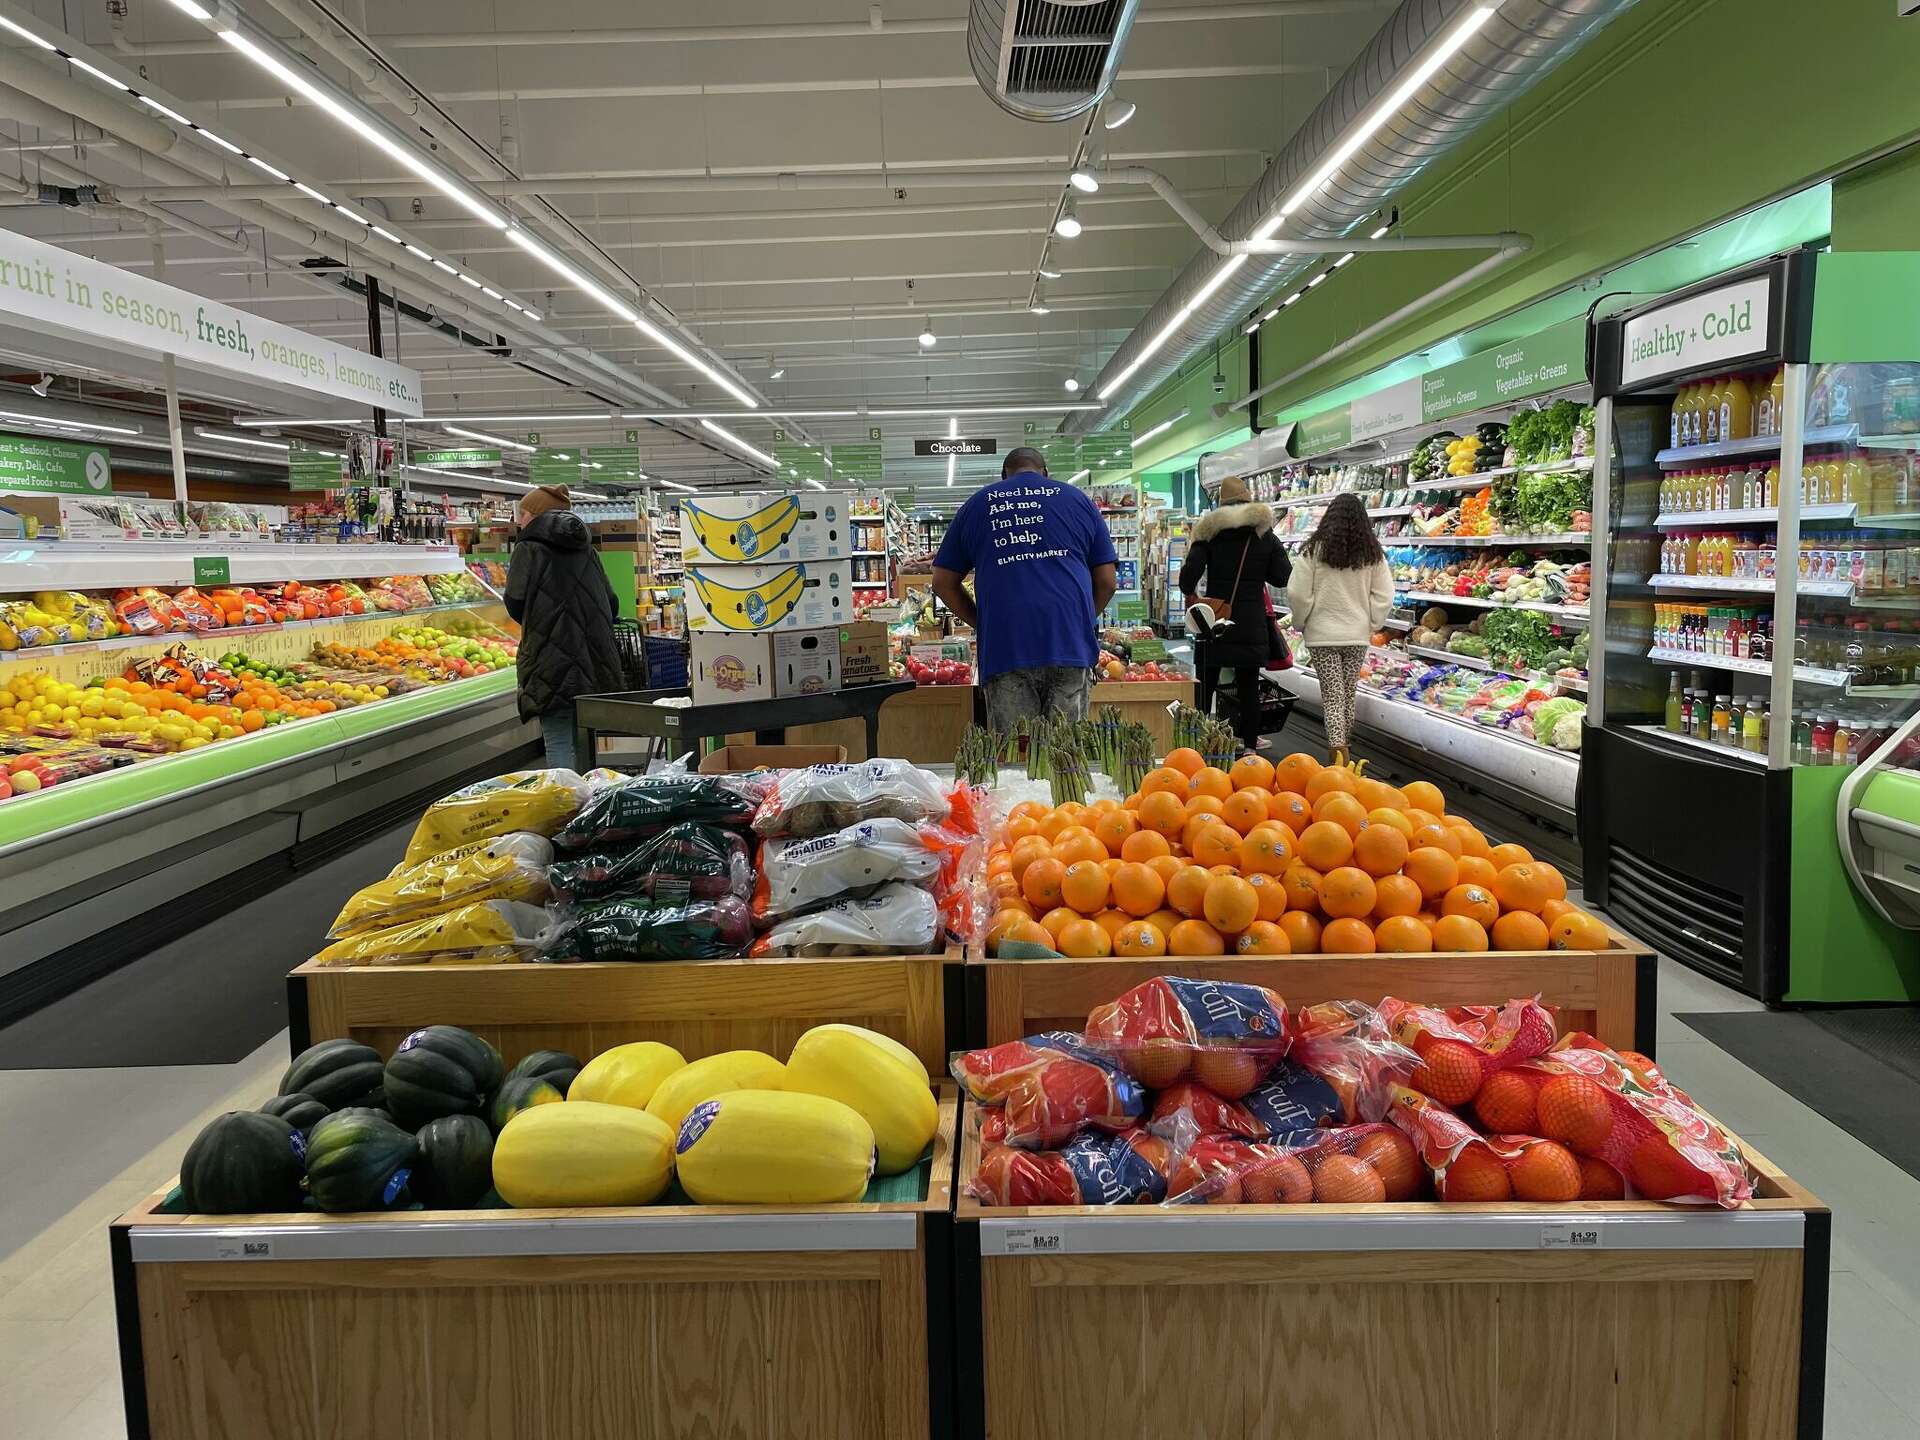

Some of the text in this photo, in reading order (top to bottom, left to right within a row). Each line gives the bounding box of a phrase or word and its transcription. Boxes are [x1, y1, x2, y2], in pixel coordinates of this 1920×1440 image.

[0, 258, 419, 403] ruit in season, fresh, oranges, lemons, etc...
[1631, 324, 1686, 363] Healthy
[1702, 300, 1752, 341] Cold
[1496, 348, 1524, 370] Organic
[1423, 375, 1446, 393] Organic
[1496, 370, 1533, 395] Vegetables
[1540, 362, 1568, 381] Greens
[1423, 393, 1452, 415] Vegetables
[1456, 389, 1478, 404] Greens
[530, 434, 537, 443] 3
[629, 431, 636, 441] 4
[775, 431, 782, 440] 5
[872, 429, 879, 438] 6
[0, 444, 13, 453] eat
[20, 444, 51, 457] Seafood,
[930, 443, 982, 453] Chocolate
[0, 457, 24, 471] akery,
[427, 453, 444, 461] Oils
[452, 453, 489, 462] Vinegars
[0, 474, 30, 487] repared
[31, 475, 53, 487] Foods
[988, 486, 1061, 502] Need help?
[989, 500, 1042, 515] Ask me,
[991, 513, 1044, 531] I'm here
[994, 530, 1042, 548] to help.
[997, 549, 1069, 566] ELM CITY MARKET
[846, 655, 871, 666] Fresh
[842, 664, 881, 676] omatoes
